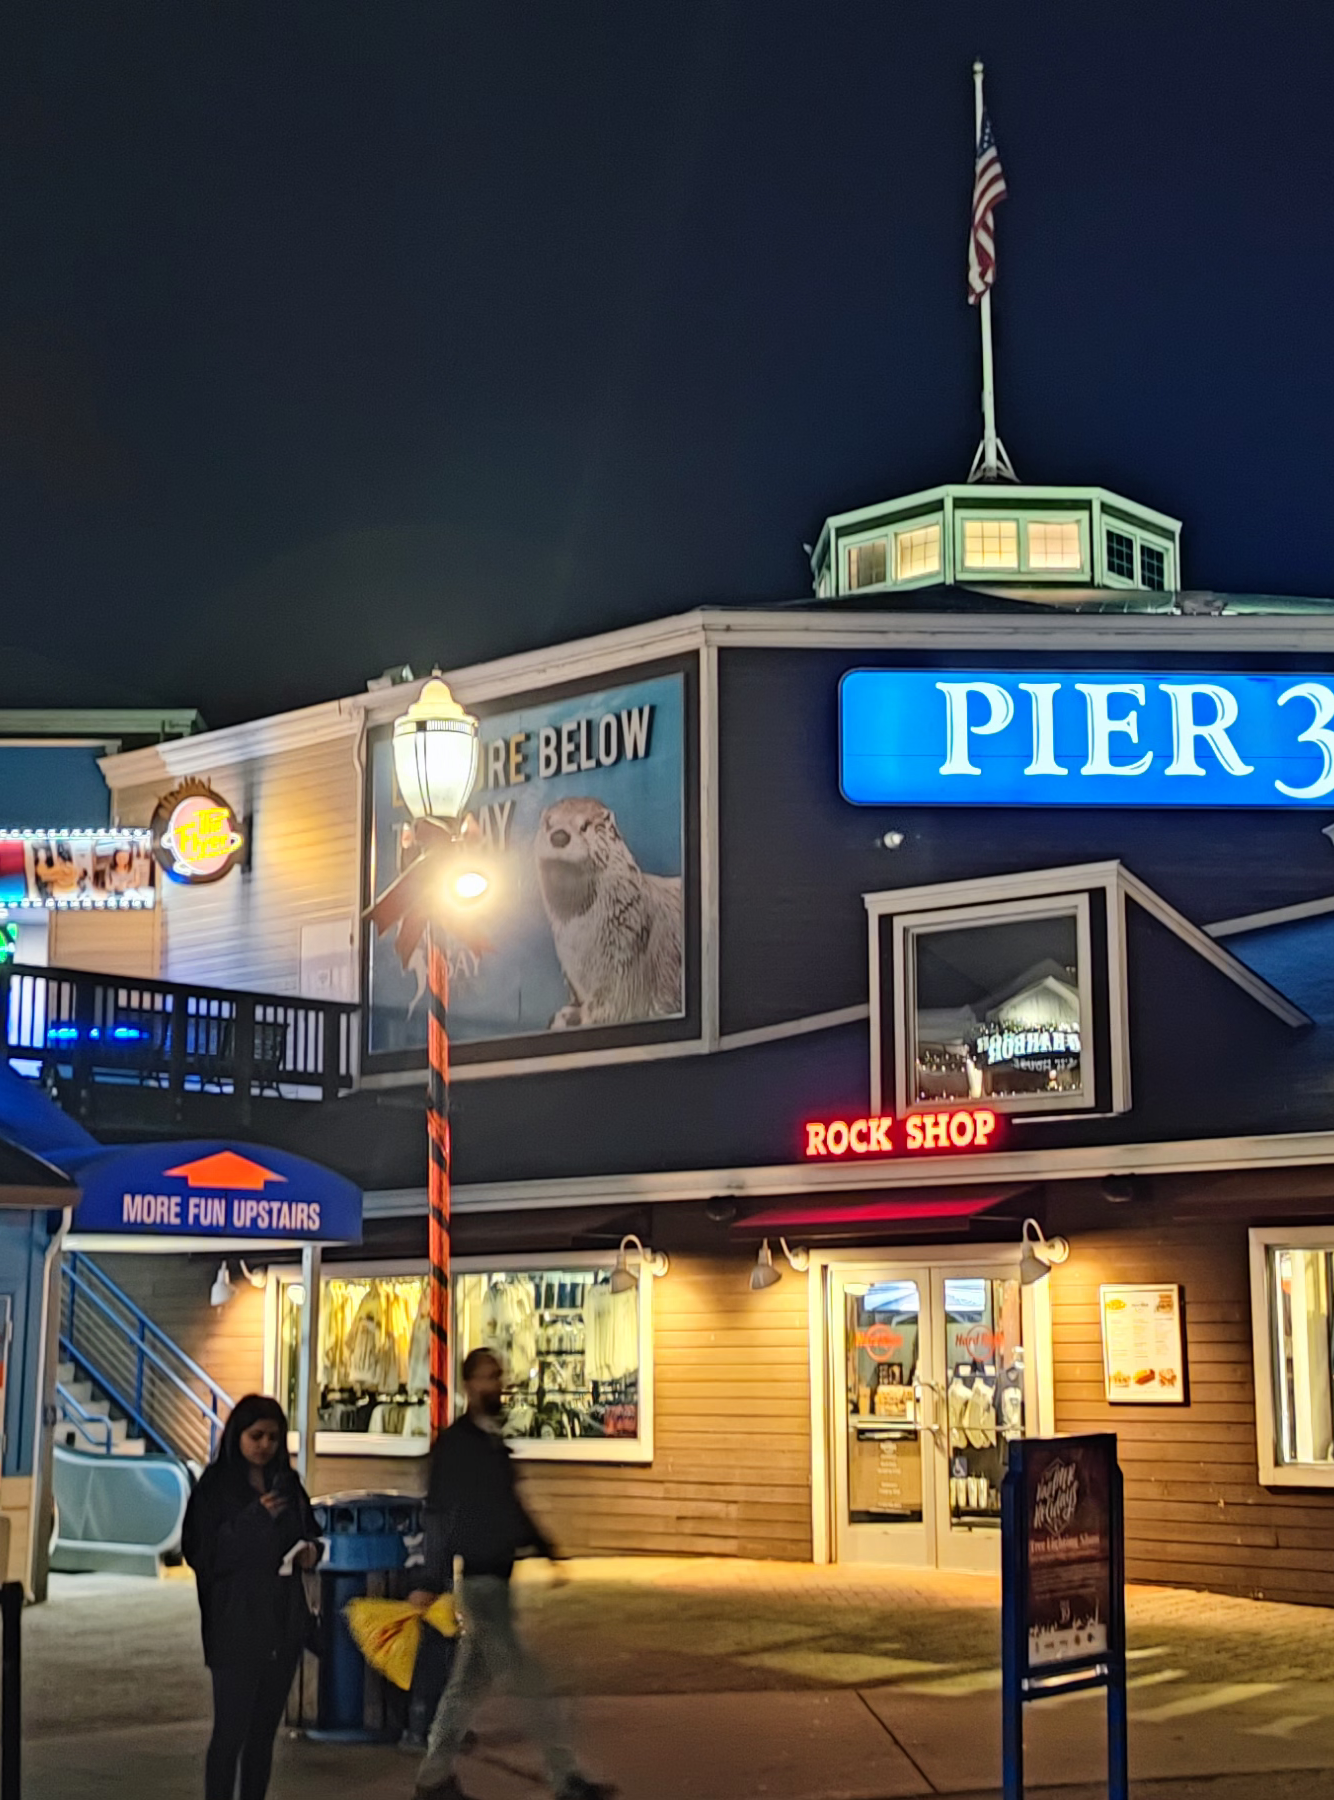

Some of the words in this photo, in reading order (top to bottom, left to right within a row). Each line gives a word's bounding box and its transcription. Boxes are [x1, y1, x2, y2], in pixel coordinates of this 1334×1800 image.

[539, 704, 652, 778] BELOW
[935, 681, 1255, 776] PIER
[174, 821, 229, 859] Flyer
[805, 1116, 894, 1156] ROCK
[905, 1110, 996, 1150] SHOP
[123, 1193, 182, 1226] MORE
[188, 1197, 226, 1228] FUN
[233, 1199, 320, 1231] UPSTAIRS
